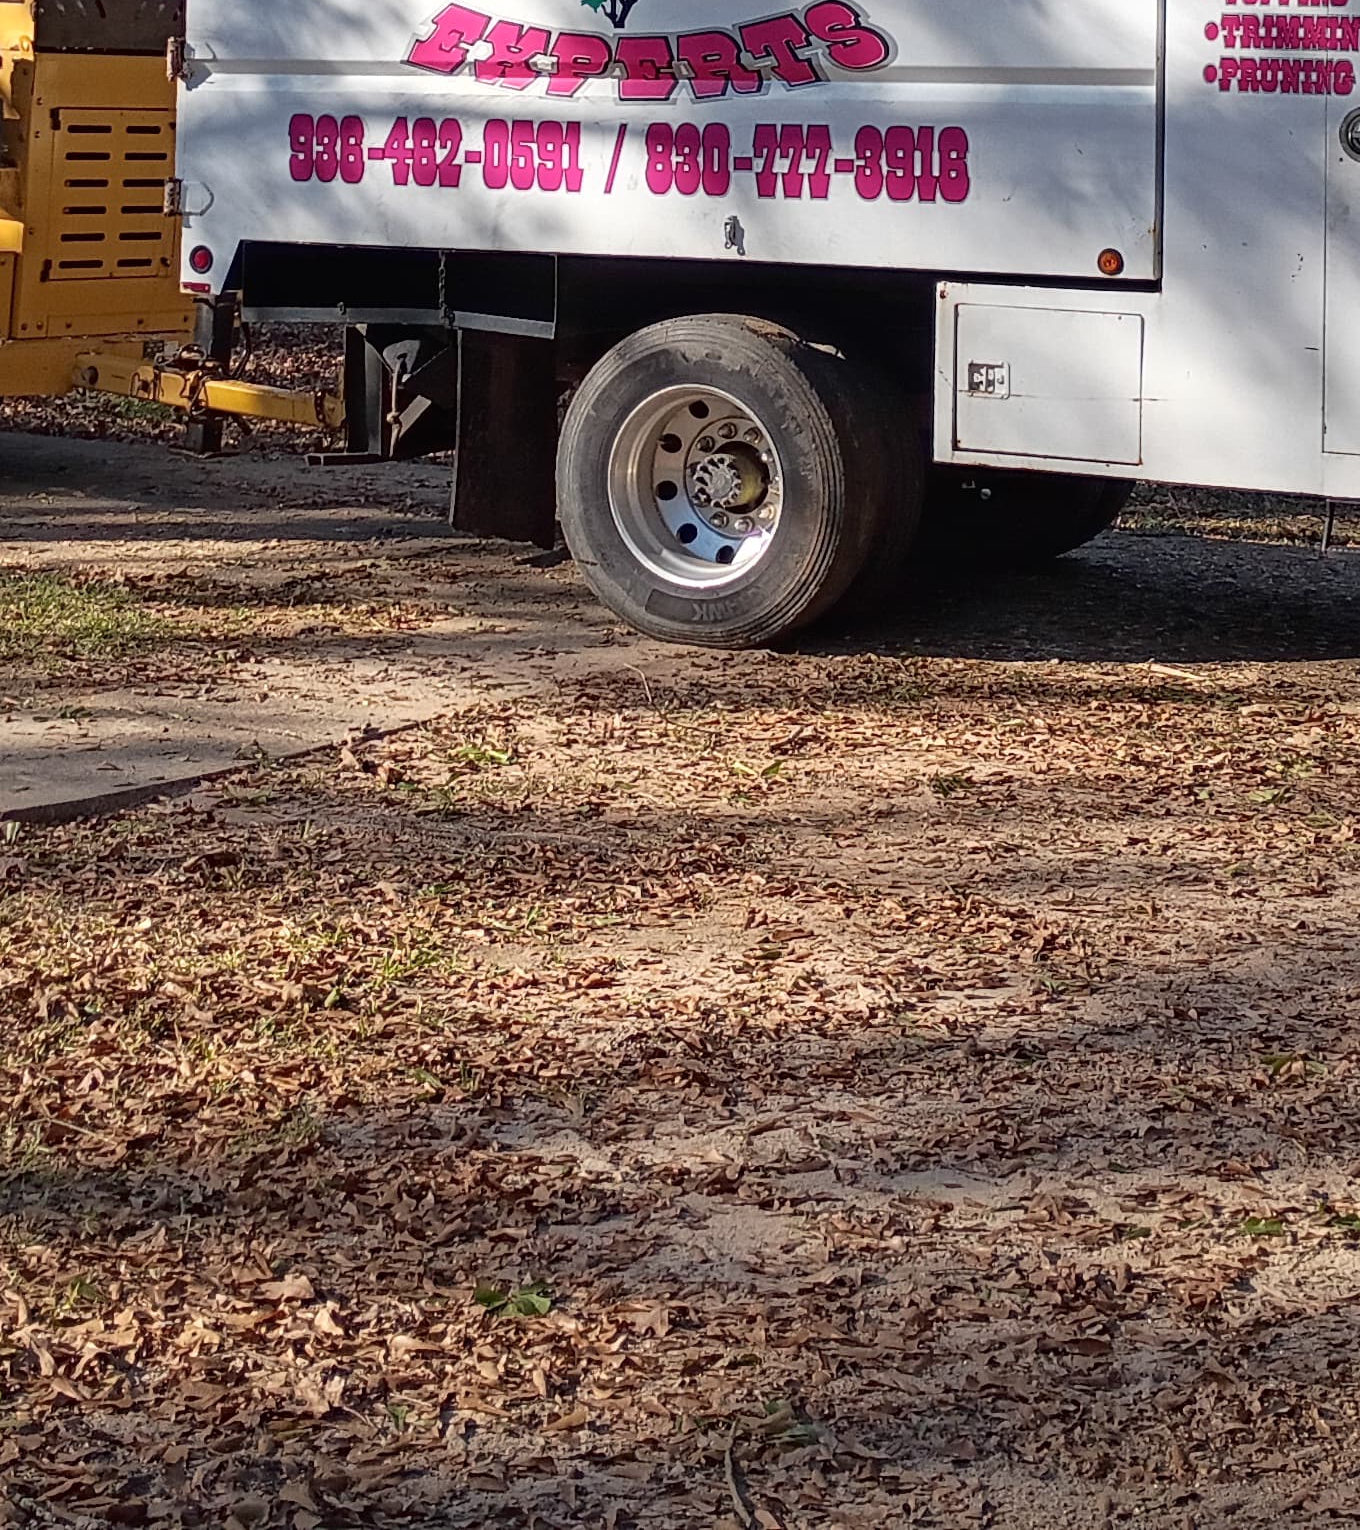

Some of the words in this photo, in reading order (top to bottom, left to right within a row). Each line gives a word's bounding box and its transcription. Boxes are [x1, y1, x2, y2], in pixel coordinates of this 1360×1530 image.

[406, 0, 889, 101] EXPERTS
[1218, 57, 1357, 96] PRUNING
[289, 113, 584, 193] 936-462-0591
[645, 122, 971, 204] 830-777-3916
